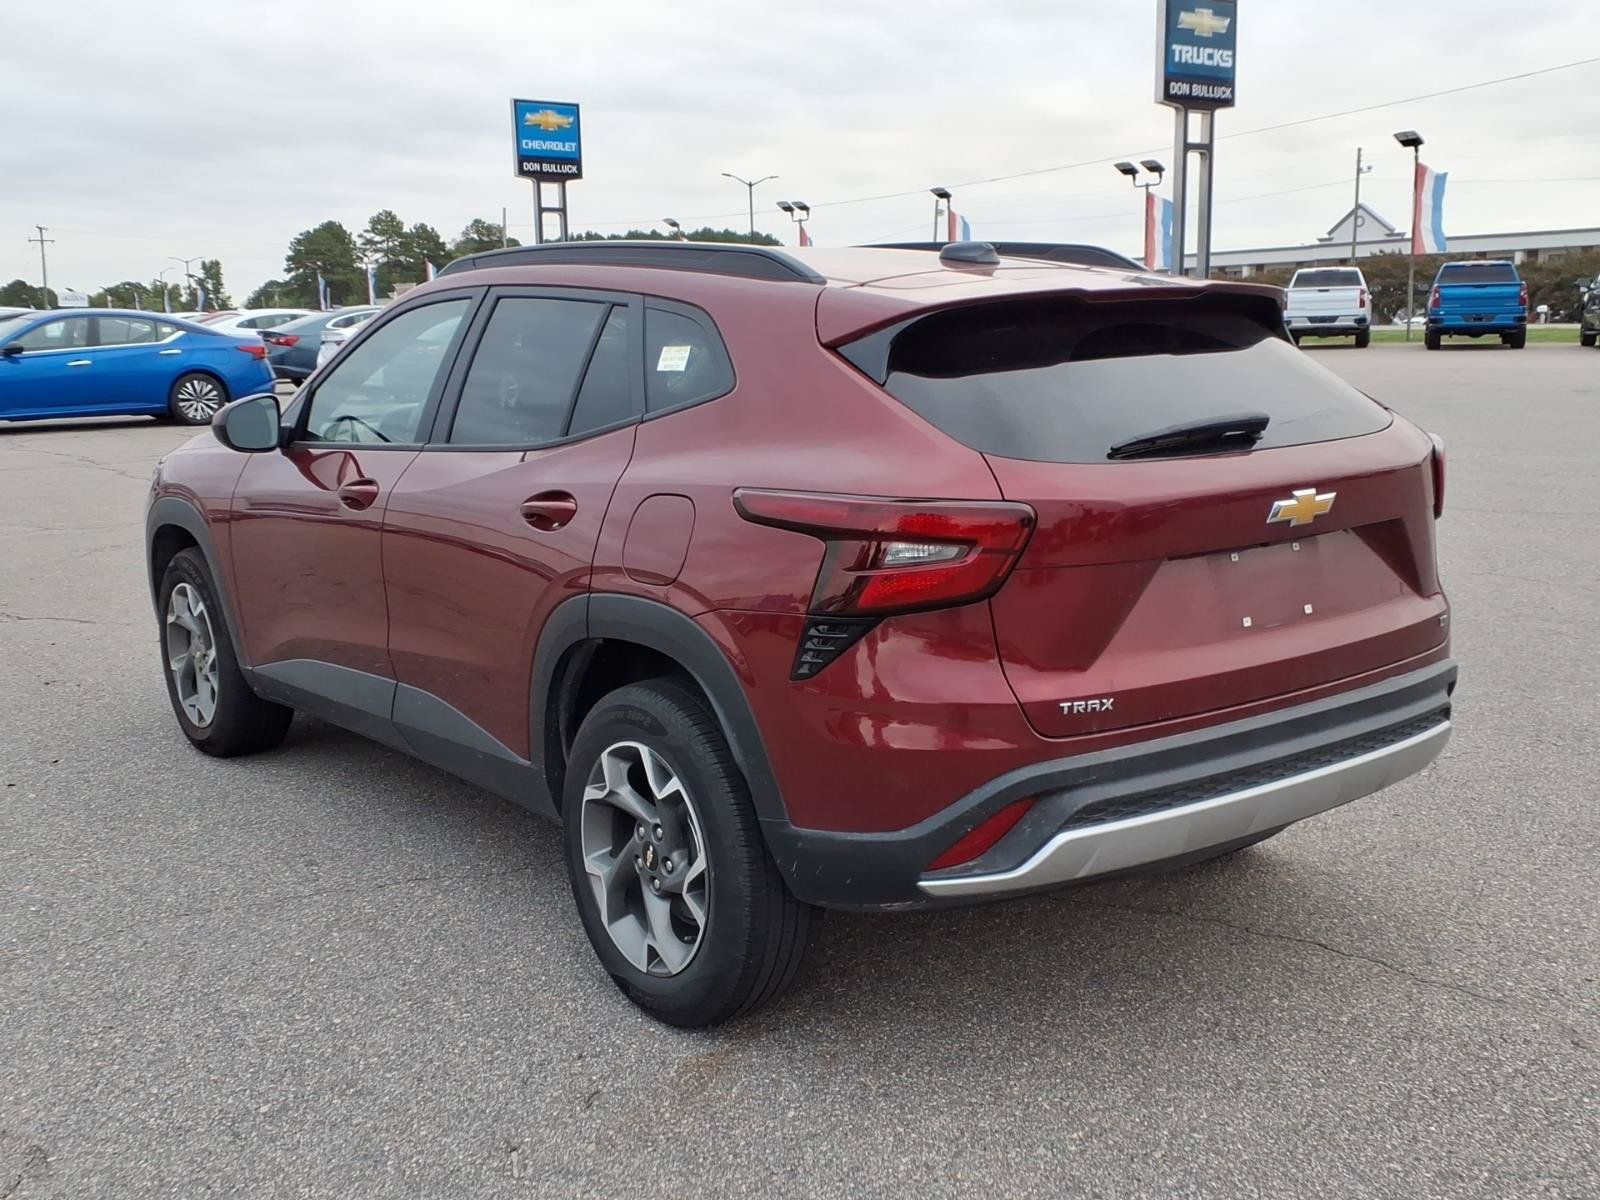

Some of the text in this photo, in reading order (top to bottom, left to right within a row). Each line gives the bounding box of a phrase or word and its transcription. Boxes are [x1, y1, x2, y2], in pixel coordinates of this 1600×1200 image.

[1172, 44, 1233, 68] TRUCKS
[1169, 81, 1233, 99] DON BULLUCK
[522, 139, 577, 152] CHEVROLET
[523, 162, 578, 174] DON BULLUCK
[1059, 698, 1114, 715] TRAX
